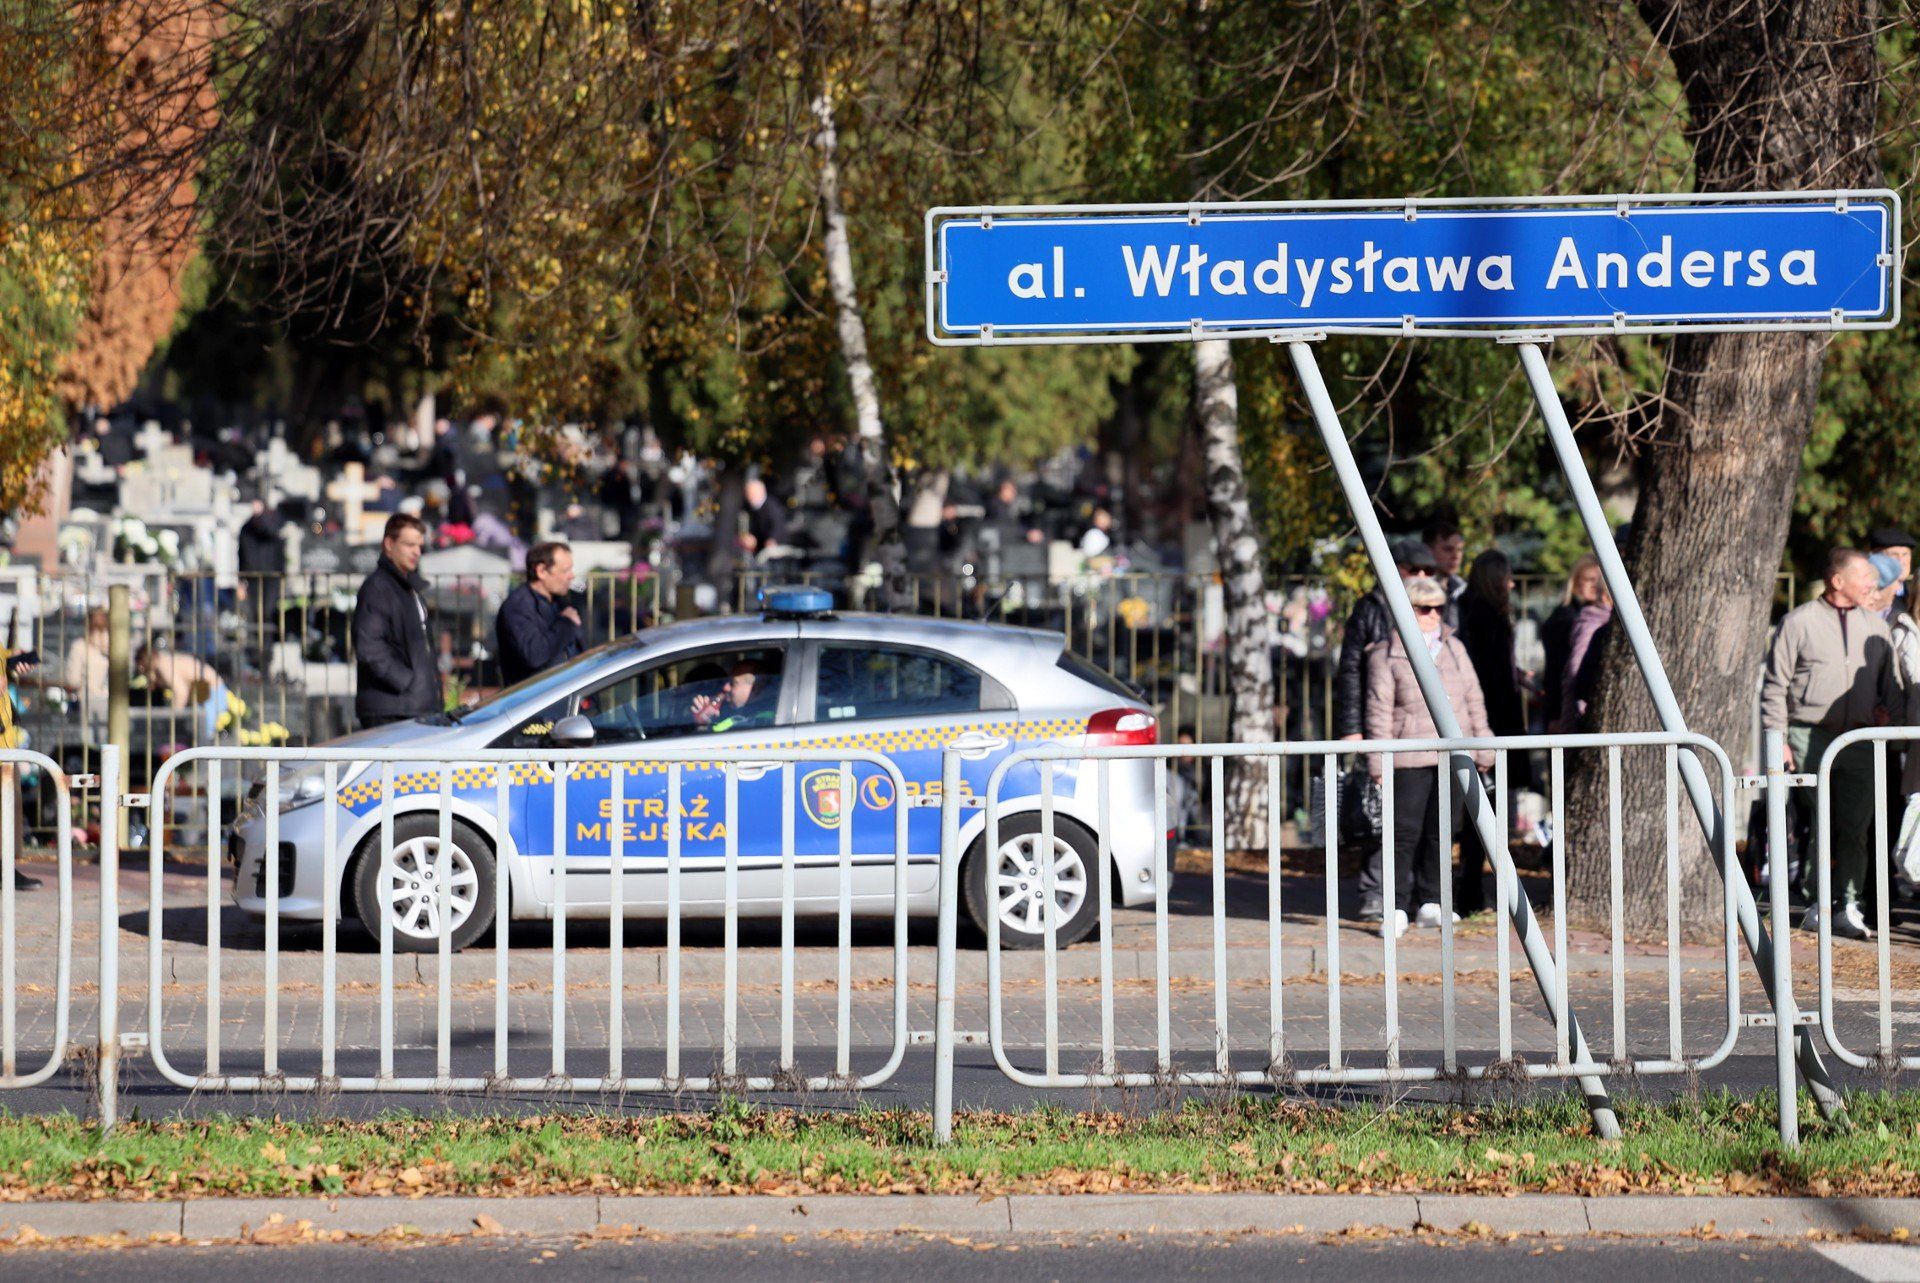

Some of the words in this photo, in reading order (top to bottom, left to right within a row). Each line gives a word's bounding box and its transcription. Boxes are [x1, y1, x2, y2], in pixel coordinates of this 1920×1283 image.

[1007, 245, 1086, 299] al.
[1121, 240, 1516, 309] Władysława
[1545, 234, 1819, 290] Andersa
